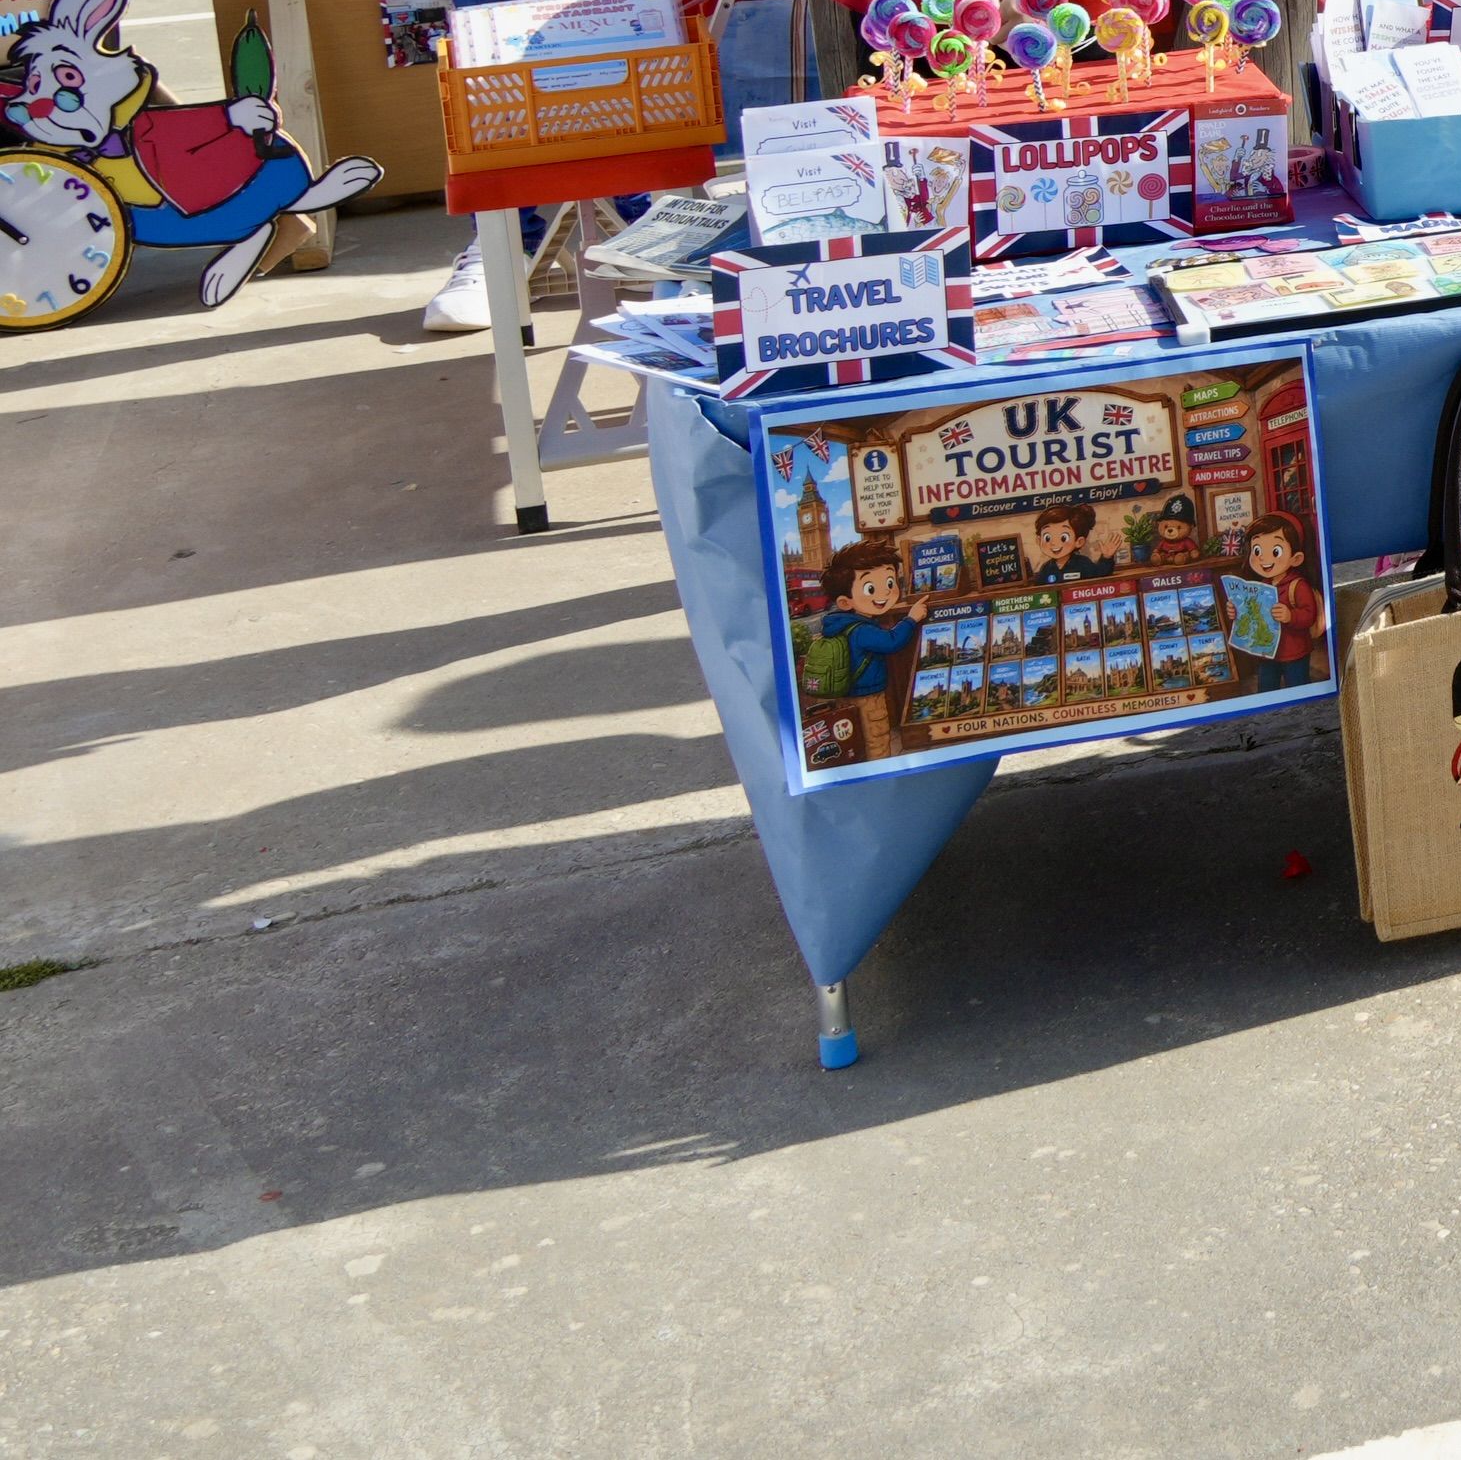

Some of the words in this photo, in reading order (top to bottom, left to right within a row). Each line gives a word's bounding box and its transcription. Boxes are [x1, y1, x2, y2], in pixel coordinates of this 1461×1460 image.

[559, 18, 616, 31] MENU
[1395, 26, 1414, 34] WHAT
[792, 119, 817, 130] Visit
[1002, 134, 1158, 173] LOLLIPOPS
[797, 167, 822, 177] Visit
[63, 178, 91, 201] 3
[665, 199, 679, 208] IN
[677, 201, 709, 213] TOON
[705, 204, 729, 213] FOR
[1210, 204, 1241, 214] Charlie
[1242, 204, 1257, 212] and
[1259, 203, 1273, 211] the
[86, 211, 112, 234] 4
[652, 212, 700, 226] STADIUM
[696, 216, 729, 229] TALKS
[1204, 212, 1245, 222] Chocolate
[1247, 209, 1279, 220] Factory
[82, 245, 110, 269] 5
[68, 274, 91, 295] 6
[786, 278, 902, 318] TRAVEL
[758, 316, 936, 364] BROCHURES
[1194, 388, 1218, 402] MAPS
[1001, 396, 1085, 439] UK
[1190, 406, 1239, 423] ATTRACTIONS
[1196, 428, 1231, 442] EVENTS
[946, 428, 1141, 477] TOURIST
[1194, 451, 1223, 463] TRAVEL
[1225, 448, 1241, 458] TIPS
[918, 465, 1082, 505] INFORMATION
[1090, 452, 1173, 481] CENTRE
[1196, 471, 1212, 482] AND
[1214, 469, 1239, 480] MORE!
[972, 501, 1017, 515] Discover
[1033, 493, 1073, 507] Explore
[1089, 486, 1122, 501] Enjoy!
[1224, 497, 1242, 505] PLAN
[1225, 505, 1242, 513] YOUR
[987, 544, 1008, 554] Let's
[986, 555, 1015, 565] explore
[1152, 575, 1182, 587] WALES
[1072, 585, 1115, 599] ENGLAND
[995, 595, 1034, 608] NORTHERN
[999, 602, 1030, 613] IRELAND
[934, 606, 972, 618] SCOTLAND
[957, 720, 987, 733] FOUR
[993, 711, 1048, 728] NATIONS,
[1053, 702, 1117, 721] COUNTLESS
[1122, 695, 1180, 712] MEMORIES!
